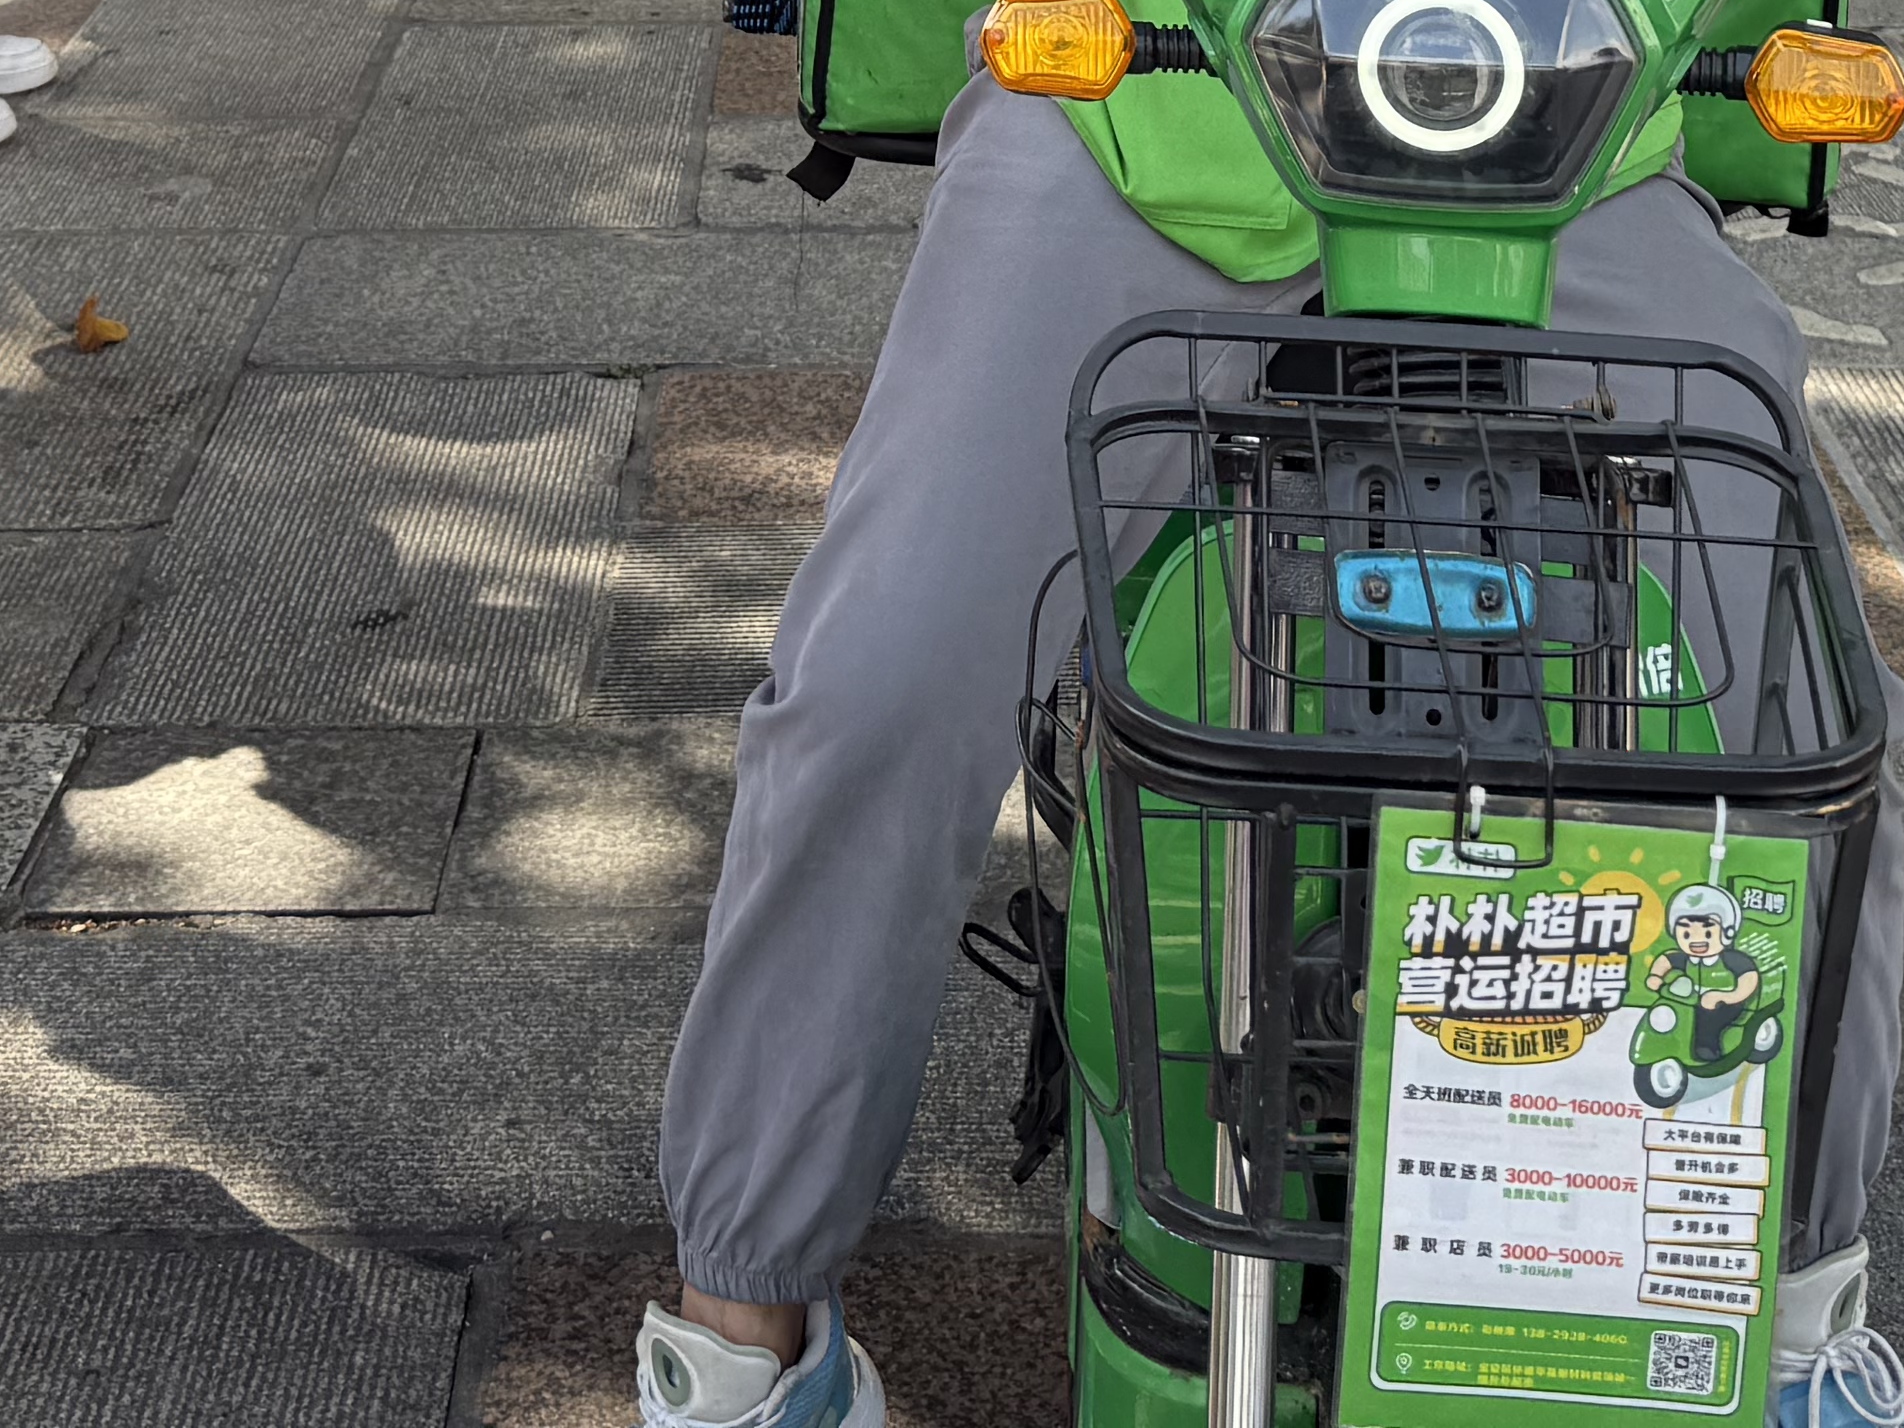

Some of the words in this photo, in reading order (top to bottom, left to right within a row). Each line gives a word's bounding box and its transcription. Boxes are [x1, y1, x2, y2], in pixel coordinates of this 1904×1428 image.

[1742, 887, 1786, 914] 招聘
[1404, 891, 1640, 953] 朴朴超市
[1396, 953, 1629, 1013] 营运招聘
[1452, 1026, 1570, 1058] 高薪诚聘
[1402, 1083, 1503, 1107] 全天班配送员
